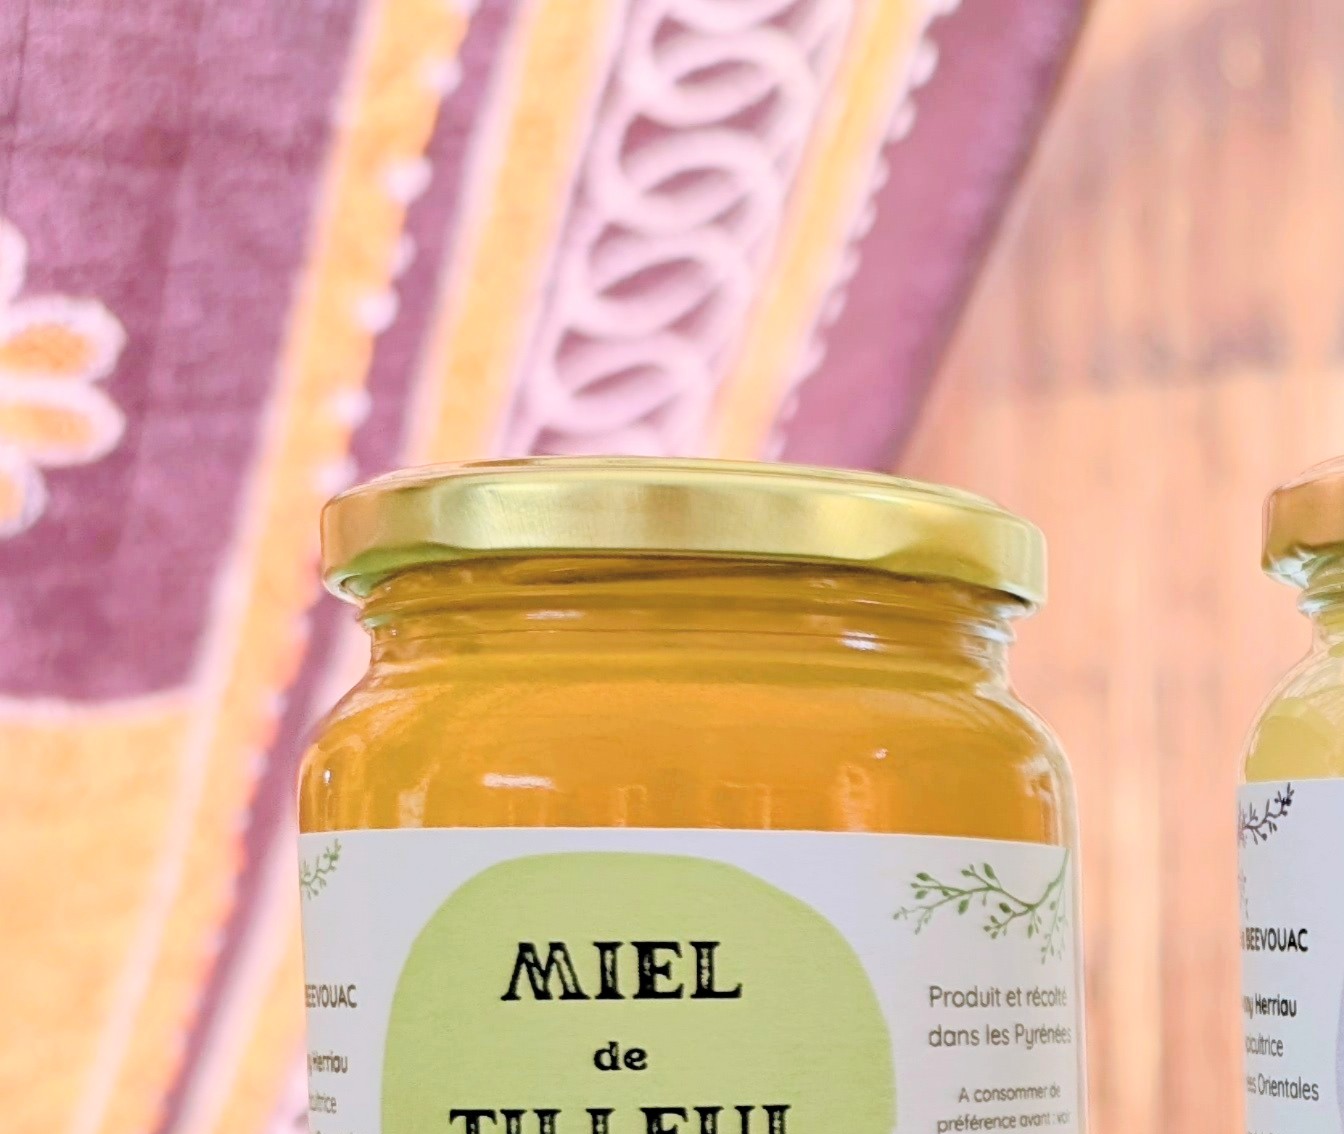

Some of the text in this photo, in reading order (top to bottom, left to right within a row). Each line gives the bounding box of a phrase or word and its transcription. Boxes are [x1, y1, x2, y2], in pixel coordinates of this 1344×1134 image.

[500, 940, 742, 1001] MIEL
[928, 985, 1001, 1008] Produit
[1006, 987, 1022, 1007] et
[928, 1024, 980, 1047] dans
[985, 1023, 1010, 1046] les
[592, 1041, 649, 1072] de
[958, 1087, 970, 1103] A
[1257, 1072, 1319, 1101] Orientales
